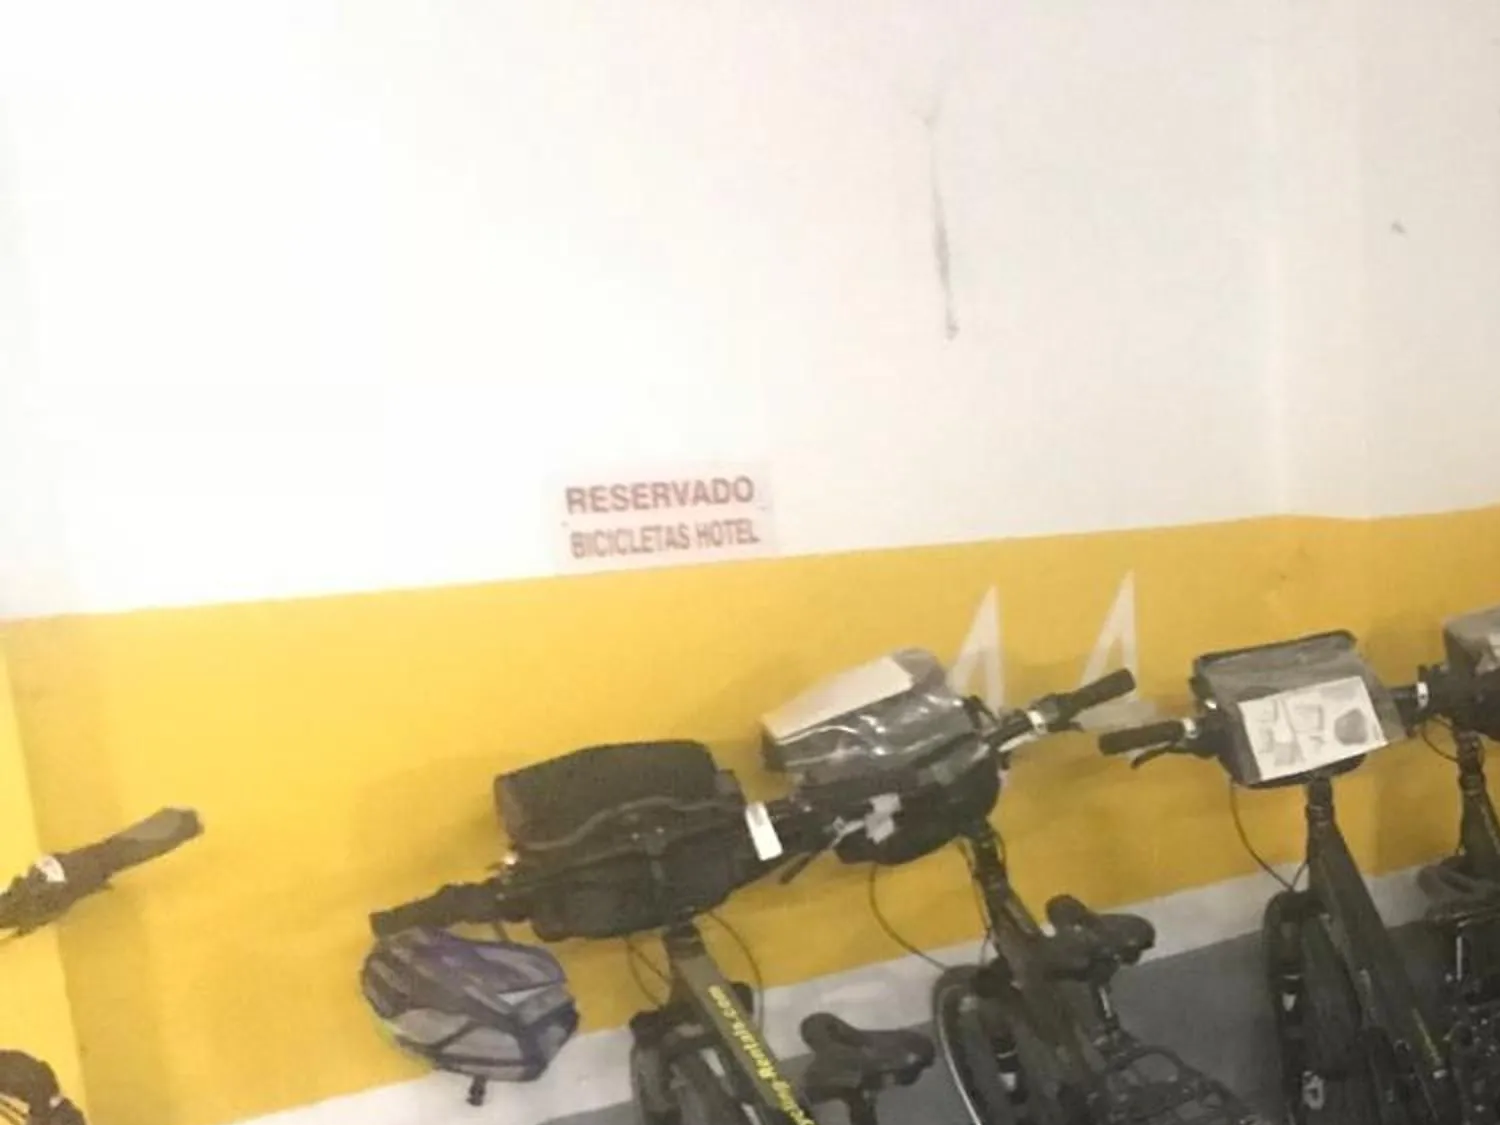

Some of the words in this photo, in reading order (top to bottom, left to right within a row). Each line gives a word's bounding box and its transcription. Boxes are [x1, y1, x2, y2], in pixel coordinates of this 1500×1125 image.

[565, 475, 755, 515] RESERVADO
[570, 522, 691, 559] BICICLETAS
[695, 517, 761, 551] HOTEL
